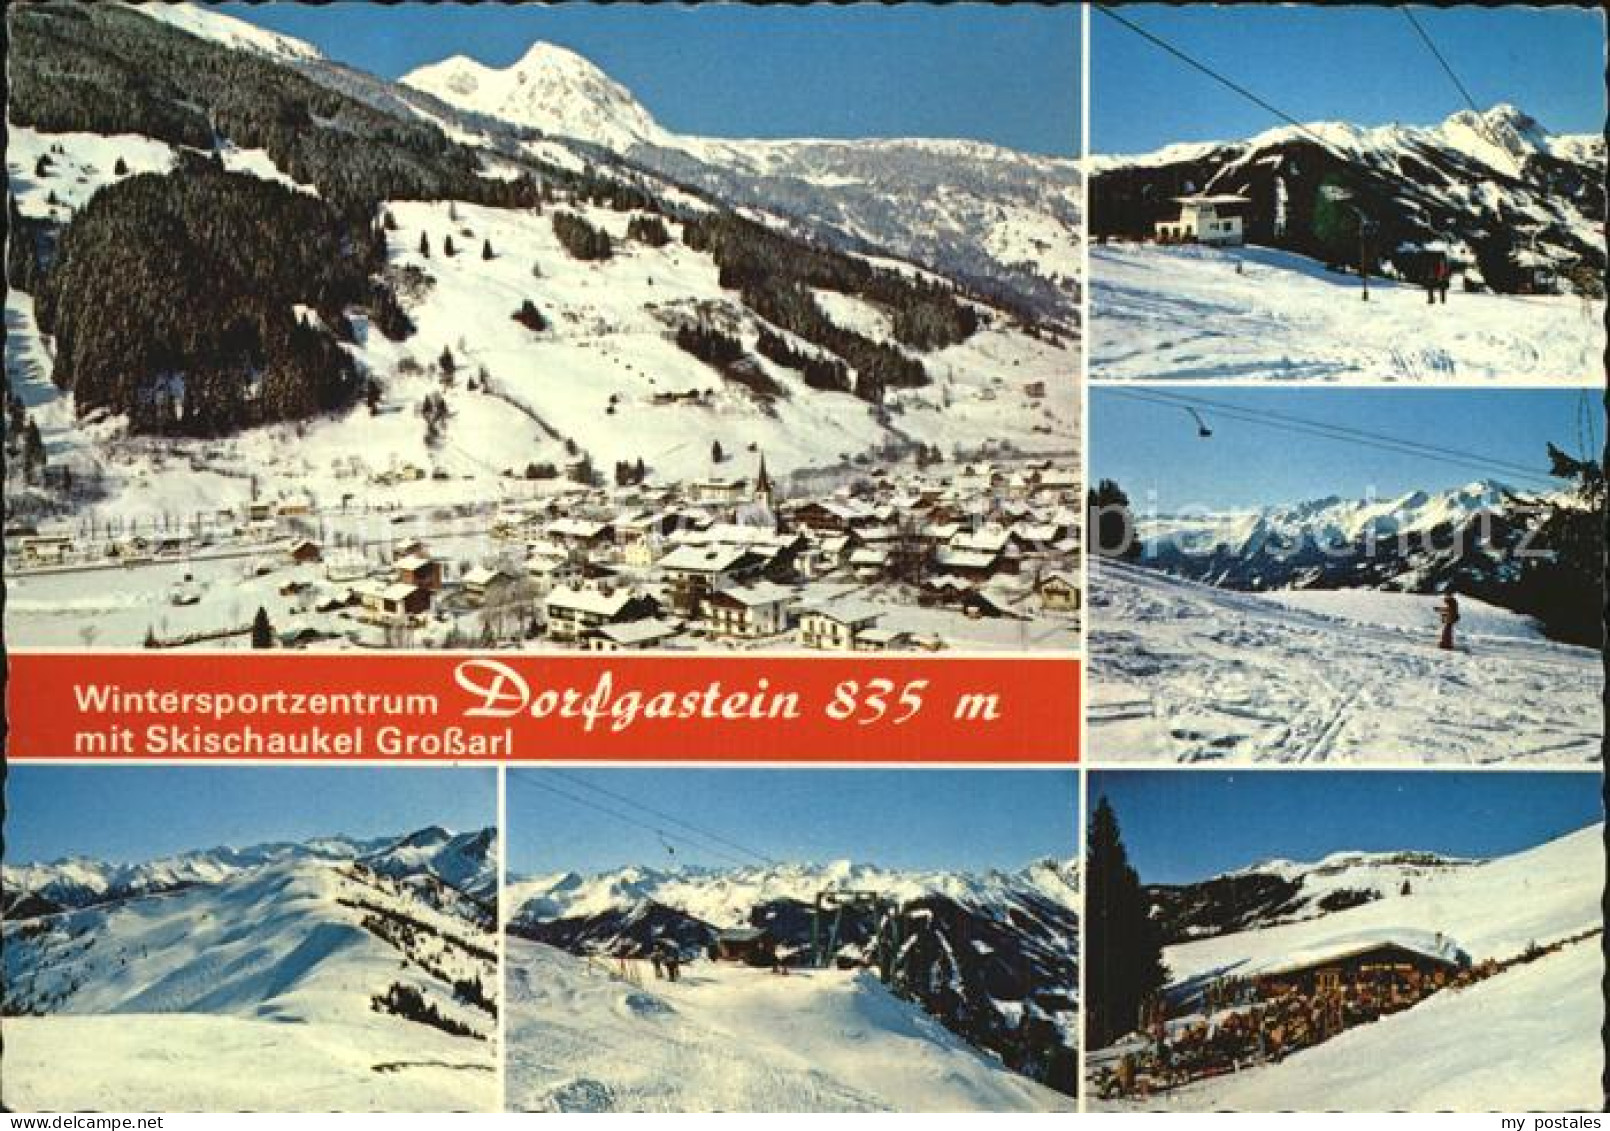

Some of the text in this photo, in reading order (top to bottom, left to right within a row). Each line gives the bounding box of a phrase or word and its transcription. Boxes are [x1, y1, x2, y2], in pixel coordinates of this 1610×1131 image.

[74, 684, 438, 720] Wintersportzentrum
[454, 658, 999, 732] Dorfgastein 835 m
[74, 726, 512, 756] mit Skischaukel Großarl
